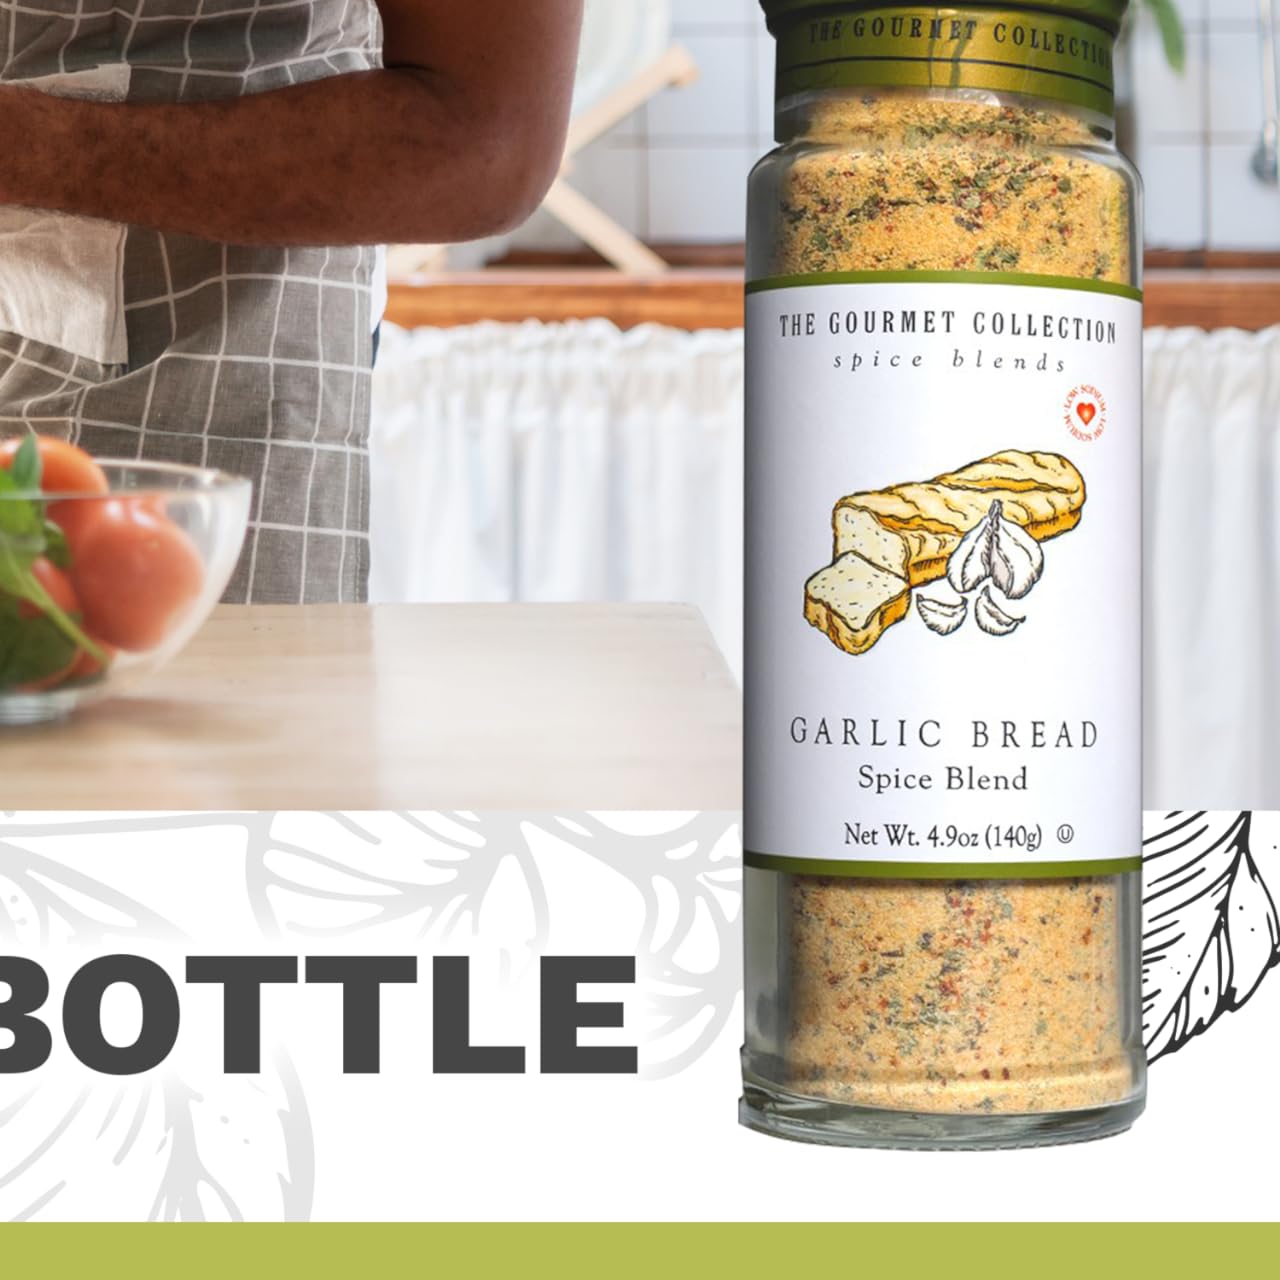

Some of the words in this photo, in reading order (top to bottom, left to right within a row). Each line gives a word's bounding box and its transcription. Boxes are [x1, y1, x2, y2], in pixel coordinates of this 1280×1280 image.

[809, 19, 842, 43] THE
[853, 17, 977, 41] GOURMET
[780, 313, 815, 337] THE
[829, 310, 955, 335] GOURMET
[973, 312, 1116, 344] COLLECTION
[833, 350, 922, 372] spice
[952, 349, 1066, 373] blends
[790, 716, 941, 748] GARLIC
[972, 720, 1098, 748] BREAD
[858, 765, 932, 794] Spice
[946, 766, 1028, 790] Blend
[844, 822, 878, 846] Net
[884, 823, 920, 847] Wt.
[927, 825, 979, 848] 4.9oz
[985, 824, 1042, 852] (140g)
